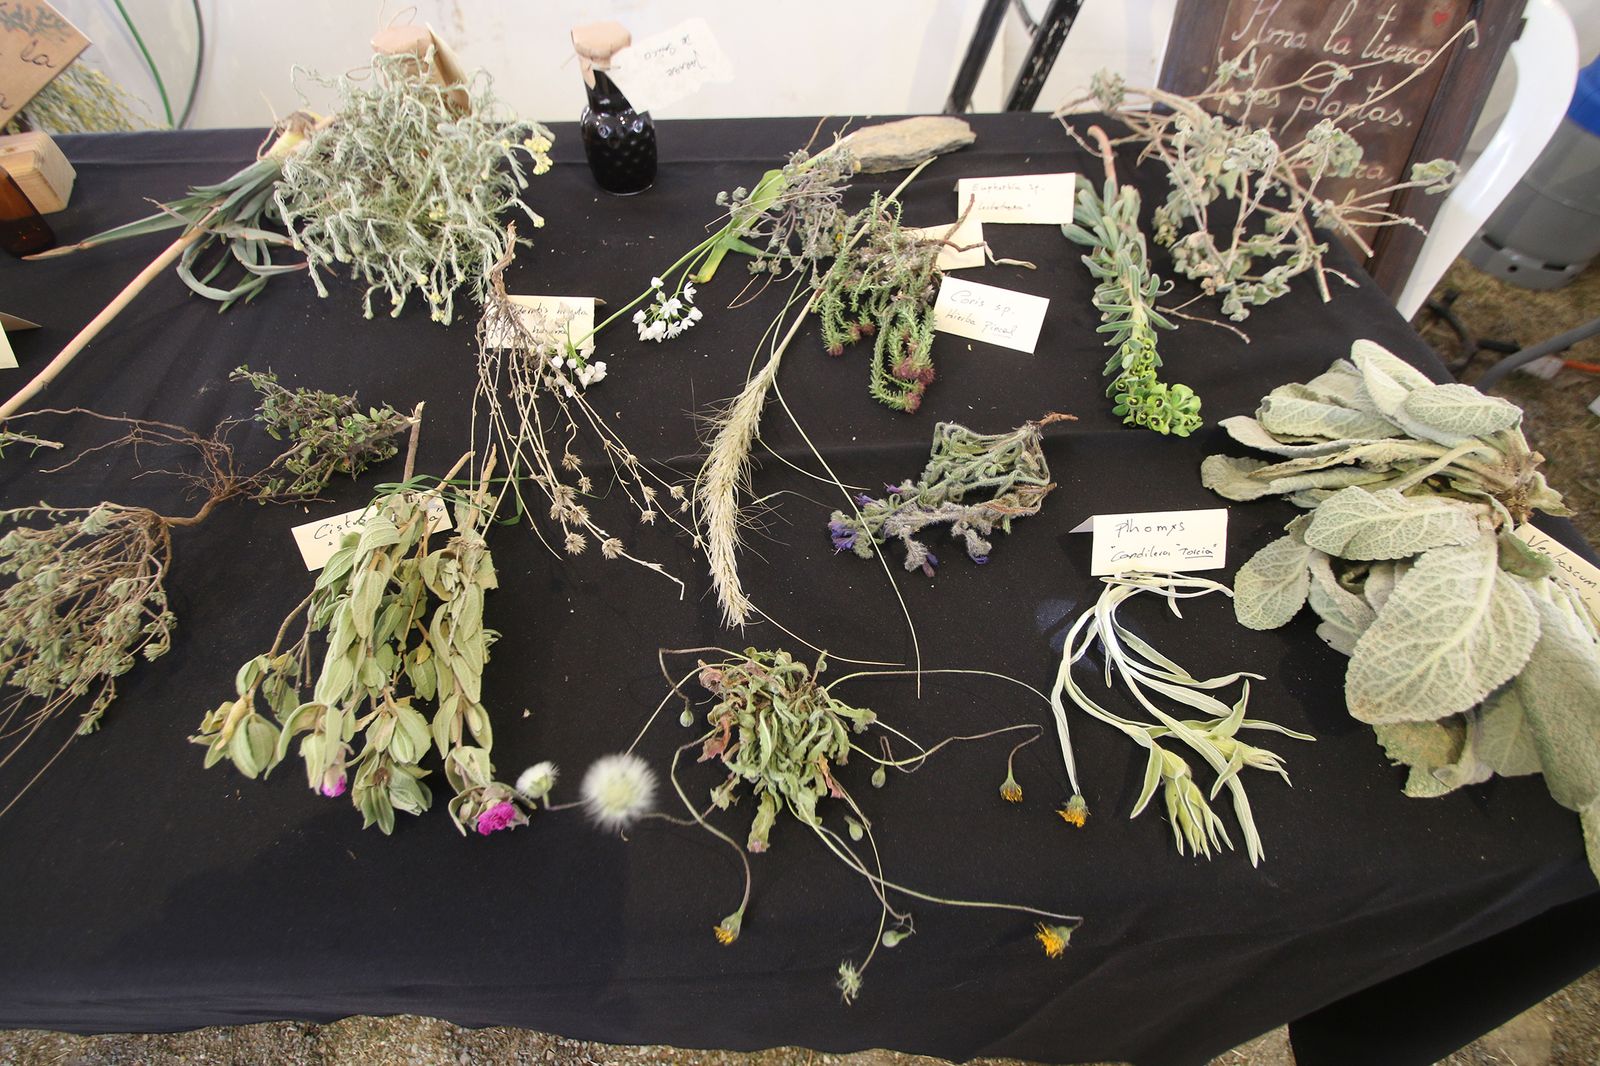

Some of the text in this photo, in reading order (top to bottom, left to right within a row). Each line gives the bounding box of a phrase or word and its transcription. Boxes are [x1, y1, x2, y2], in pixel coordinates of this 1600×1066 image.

[1323, 0, 1357, 55] la
[1361, 4, 1432, 66] tierra
[21, 39, 56, 68] la
[945, 309, 977, 326] Hierba
[951, 290, 1015, 317] Coris sp.
